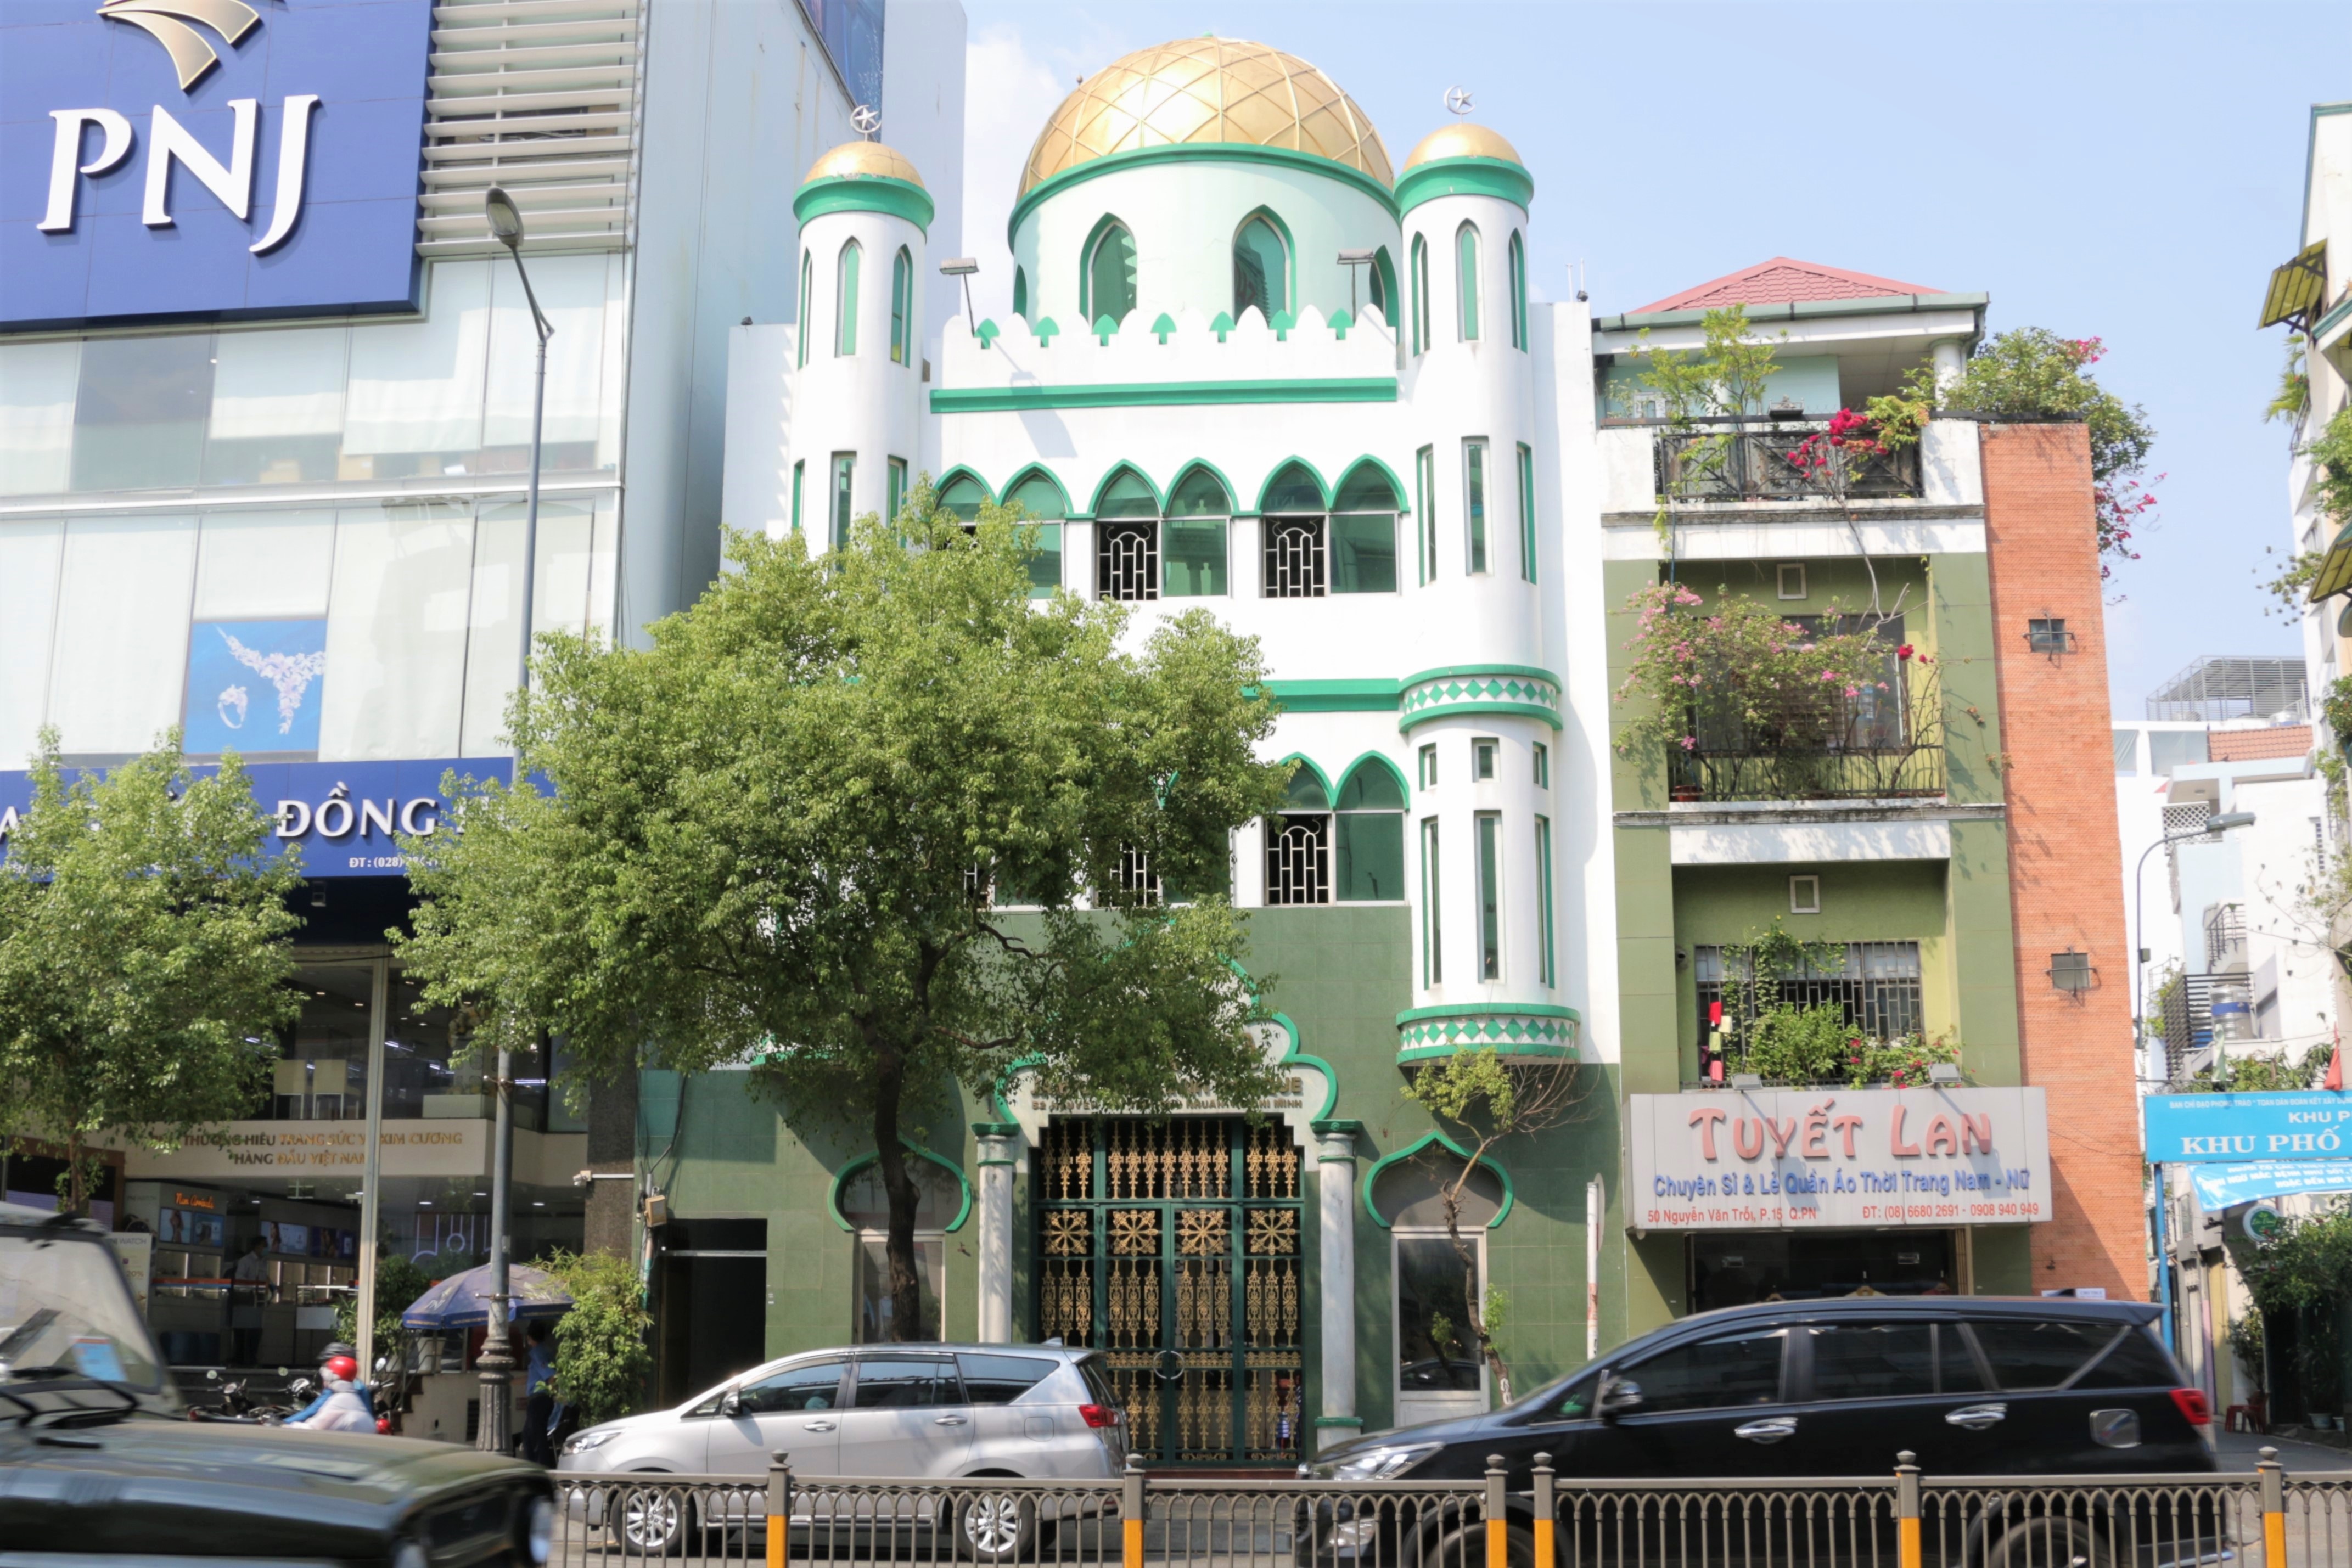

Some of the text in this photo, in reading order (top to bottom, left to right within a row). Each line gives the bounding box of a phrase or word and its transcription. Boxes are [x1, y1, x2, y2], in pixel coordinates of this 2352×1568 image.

[37, 94, 319, 252] PNJ
[274, 781, 437, 837] ĐỒNG
[1689, 1098, 1992, 1160] TUYẾT LAN
[2288, 1111, 2331, 1123] KHU
[280, 1133, 324, 1145] TRANG
[2180, 1125, 2341, 1154] KHU PHỐ
[234, 1150, 273, 1165] HÀNG
[310, 1149, 337, 1166] VIỆT
[1653, 1174, 1716, 1201] Chuyên
[1721, 1171, 1738, 1195] Sỉ
[1743, 1173, 1754, 1196] &
[1759, 1170, 1780, 1195] Lẻ
[1785, 1168, 1828, 1195] Quần
[1833, 1167, 1856, 1193] Áo
[1860, 1170, 1898, 1193] Thời
[1901, 1170, 1949, 1196] Trang
[1954, 1169, 1991, 1192] Nam
[2006, 1168, 2030, 1190] Nữ
[1648, 1209, 1660, 1223] 50
[1664, 1207, 1704, 1226] Nguyễn
[1708, 1207, 1728, 1221] Văn
[1789, 1207, 1817, 1221] Q.PN
[1862, 1205, 1881, 1219] ĐT:
[1885, 1205, 1905, 1222] (08)
[1908, 1204, 1933, 1218] 6680
[1935, 1204, 1959, 1217] 2691
[1971, 1203, 1995, 1216] 0908
[1999, 1202, 2017, 1216] 940
[2020, 1202, 2039, 1215] 949
